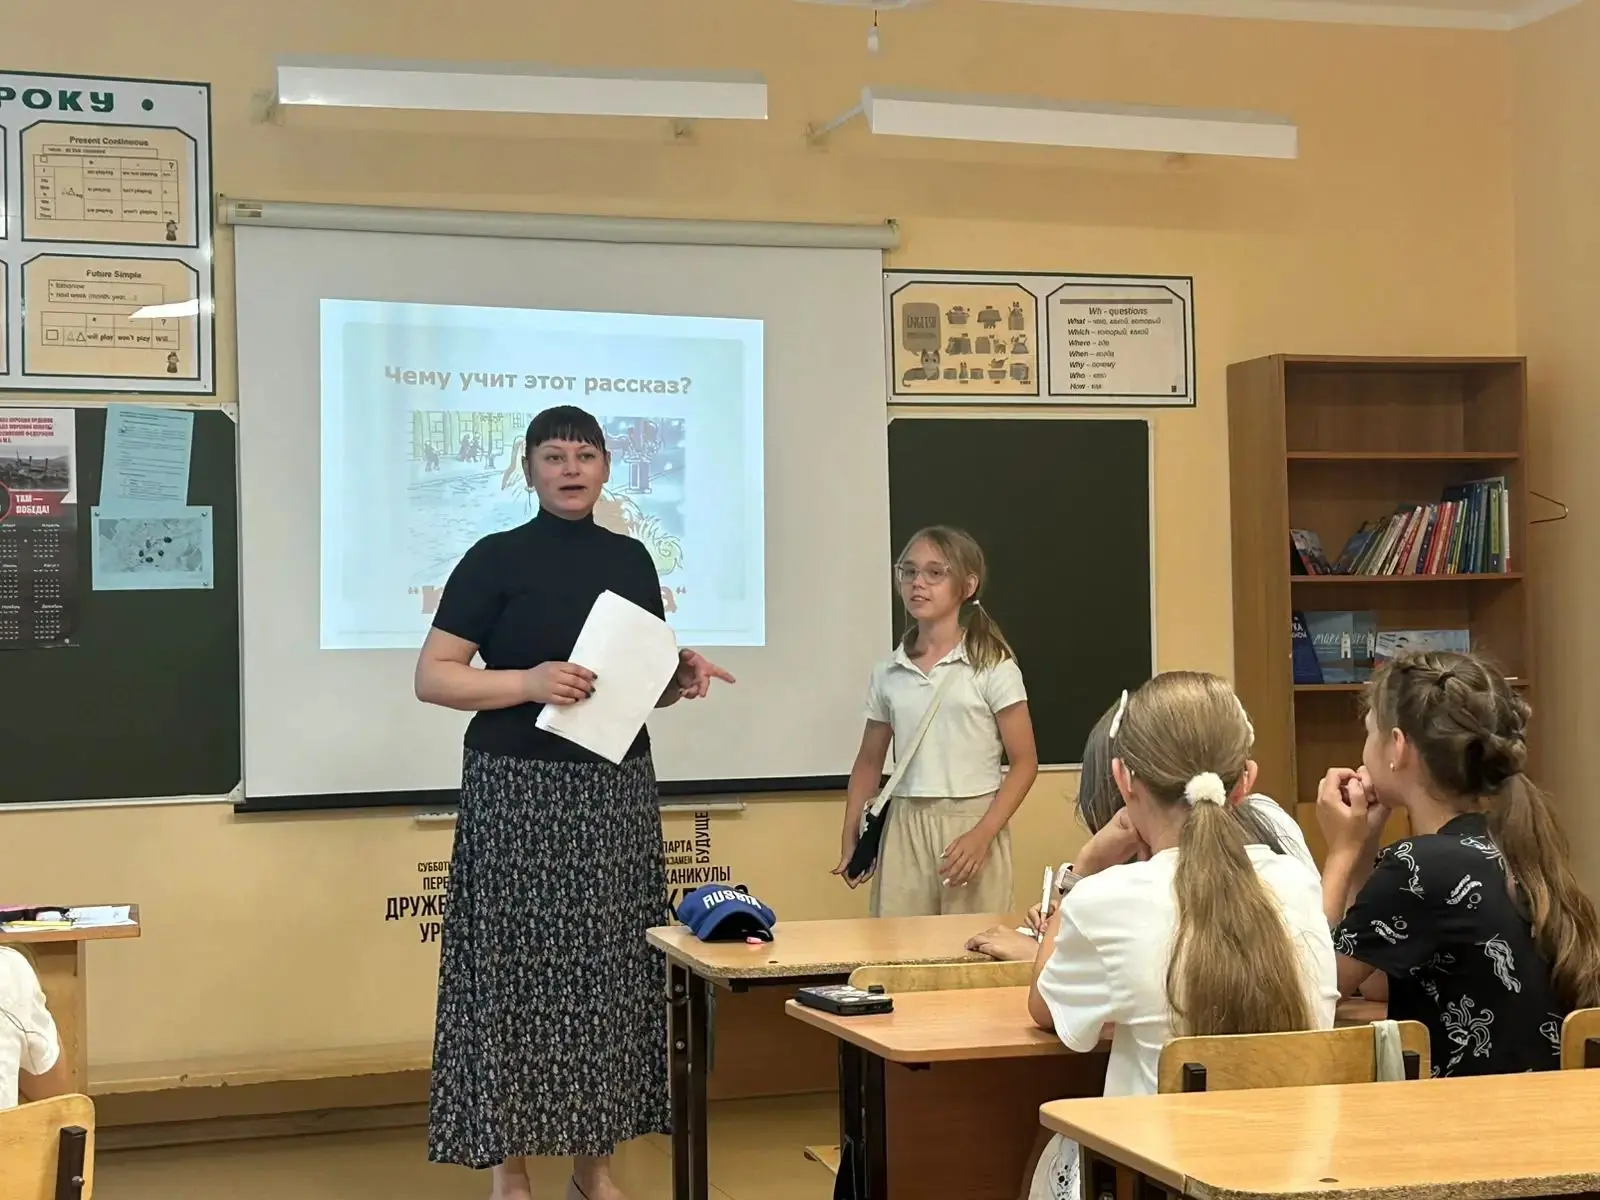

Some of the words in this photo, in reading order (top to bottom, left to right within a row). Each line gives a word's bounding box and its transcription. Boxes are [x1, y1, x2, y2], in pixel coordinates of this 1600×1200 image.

[69, 136, 101, 145] Present
[102, 137, 149, 147] Continuous
[86, 269, 112, 278] Future
[114, 270, 142, 279] Simple
[1089, 307, 1102, 315] Wh
[1109, 307, 1148, 316] questions
[1068, 328, 1090, 336] Which
[1069, 361, 1085, 369] Why
[385, 365, 452, 390] Чему
[459, 372, 518, 391] учит
[524, 375, 577, 391] этот
[584, 376, 692, 396] рассказ?
[15, 494, 33, 503] ТАМ
[15, 505, 50, 515] ПОБЕДА!
[695, 811, 711, 864] БУДУЩЕ
[663, 839, 693, 854] ПАРТА
[666, 855, 693, 865] КЗАМЕН
[417, 861, 451, 872] СУББОТ
[702, 889, 762, 909] RUSSIA
[419, 922, 444, 943] УР
